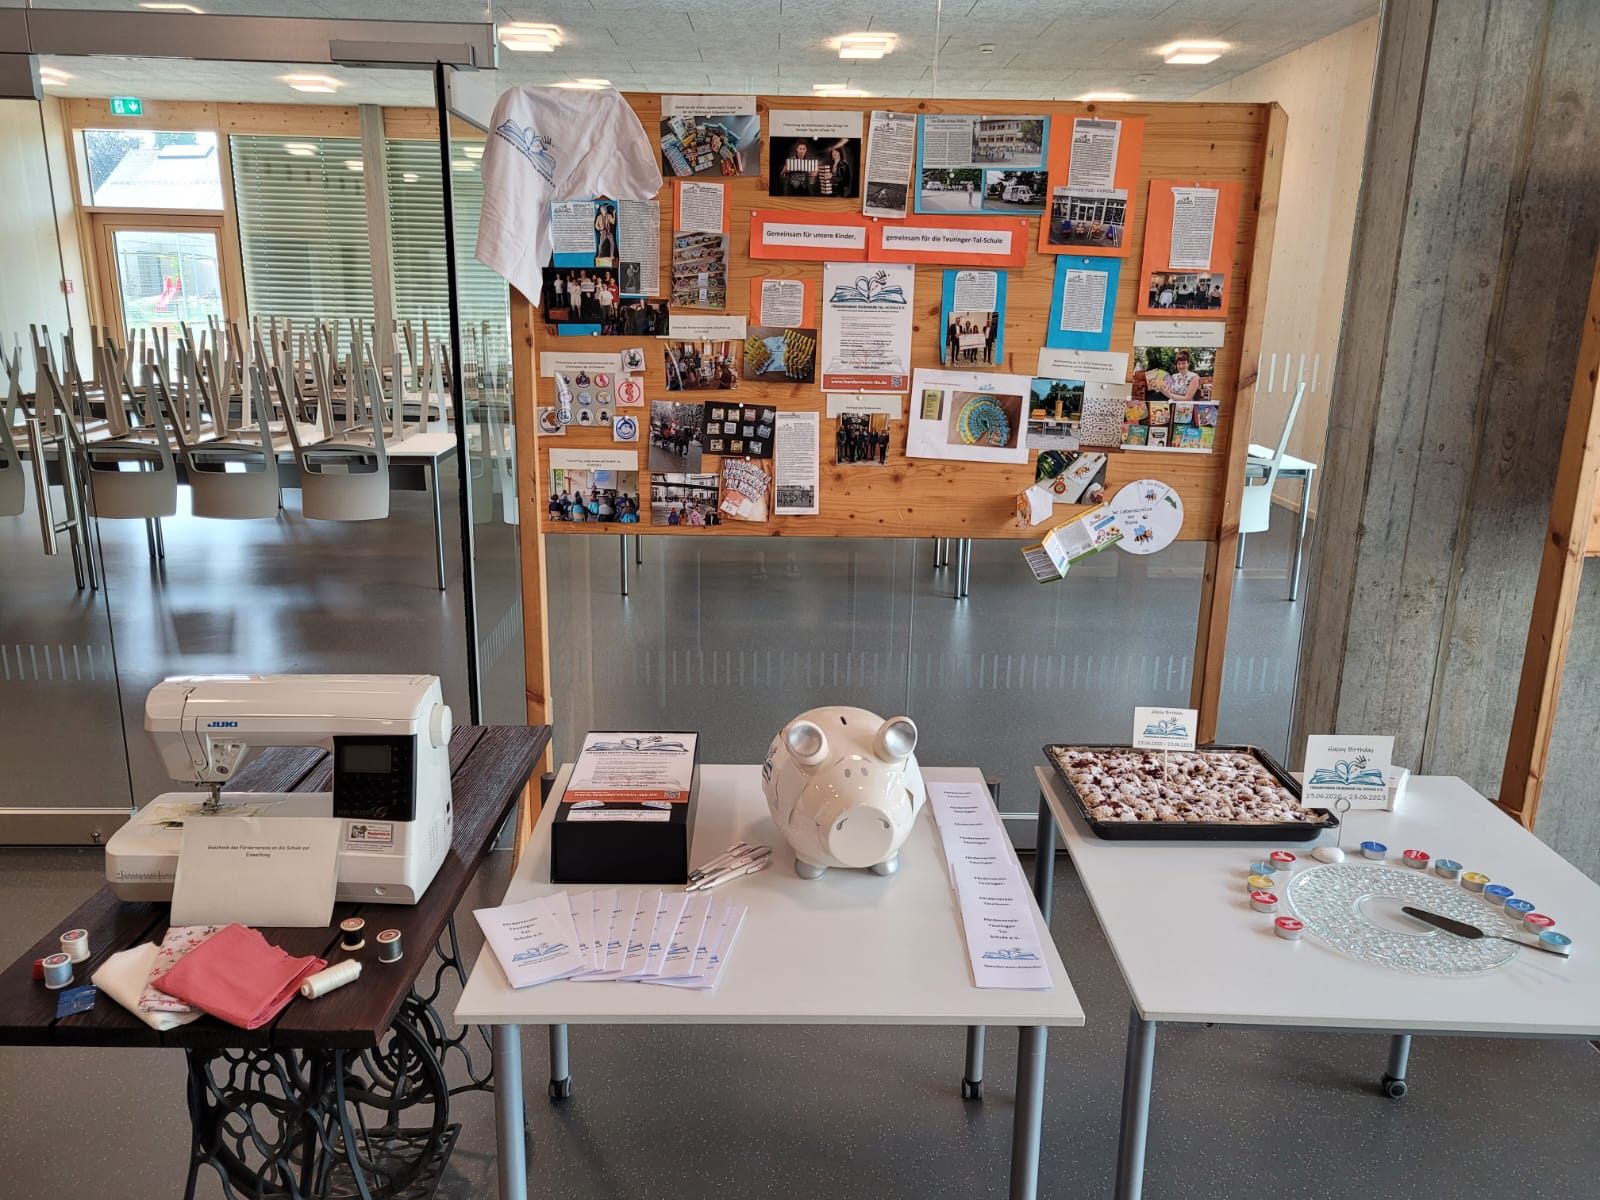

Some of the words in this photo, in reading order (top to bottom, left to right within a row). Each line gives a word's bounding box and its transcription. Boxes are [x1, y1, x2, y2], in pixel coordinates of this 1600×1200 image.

[766, 230, 801, 238] Gemeinsam
[835, 232, 857, 240] Kinder,
[942, 235, 1003, 244] Teuringer-Tal-Schule
[1327, 745, 1346, 753] Happy
[1348, 746, 1374, 754] Birthday
